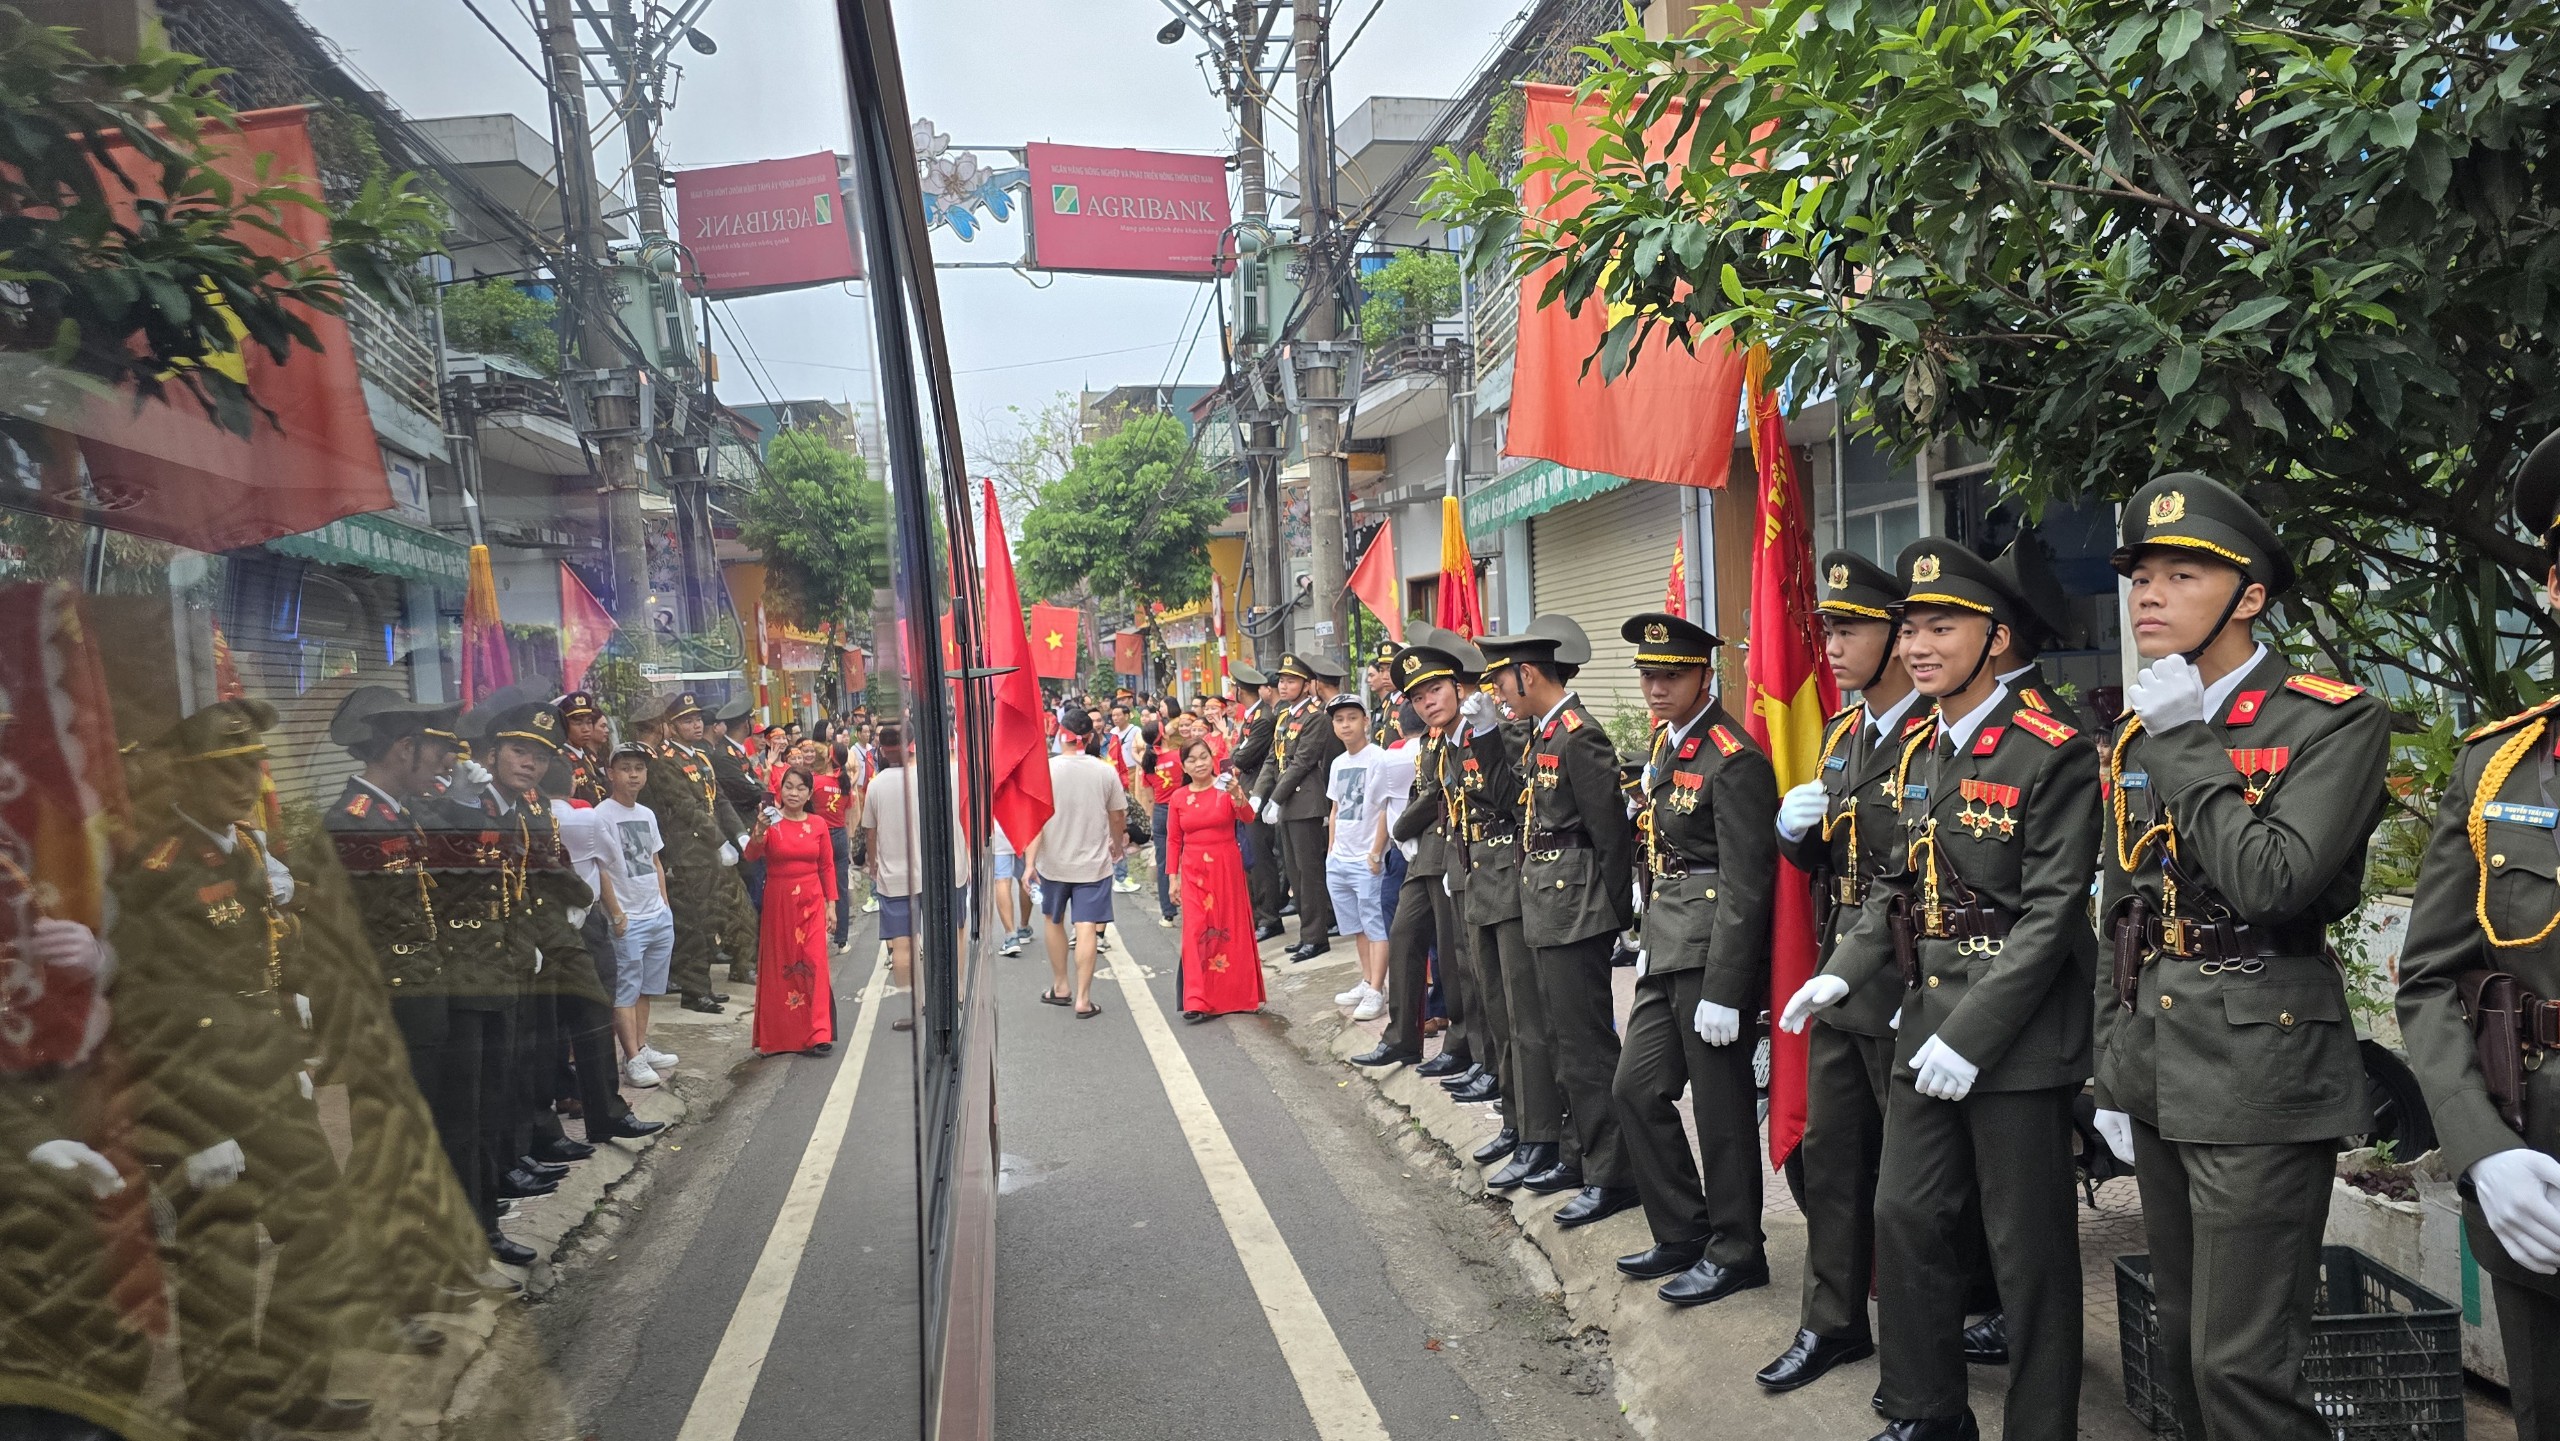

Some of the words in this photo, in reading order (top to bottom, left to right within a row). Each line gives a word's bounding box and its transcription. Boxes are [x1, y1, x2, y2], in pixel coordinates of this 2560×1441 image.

[1051, 165, 1067, 174] NGÂN
[1068, 166, 1084, 175] HÀNG
[1085, 167, 1100, 177] NÔNG
[1121, 170, 1129, 178] VÀ
[1201, 175, 1213, 183] NAM
[1087, 196, 1215, 222] AGRIBANK
